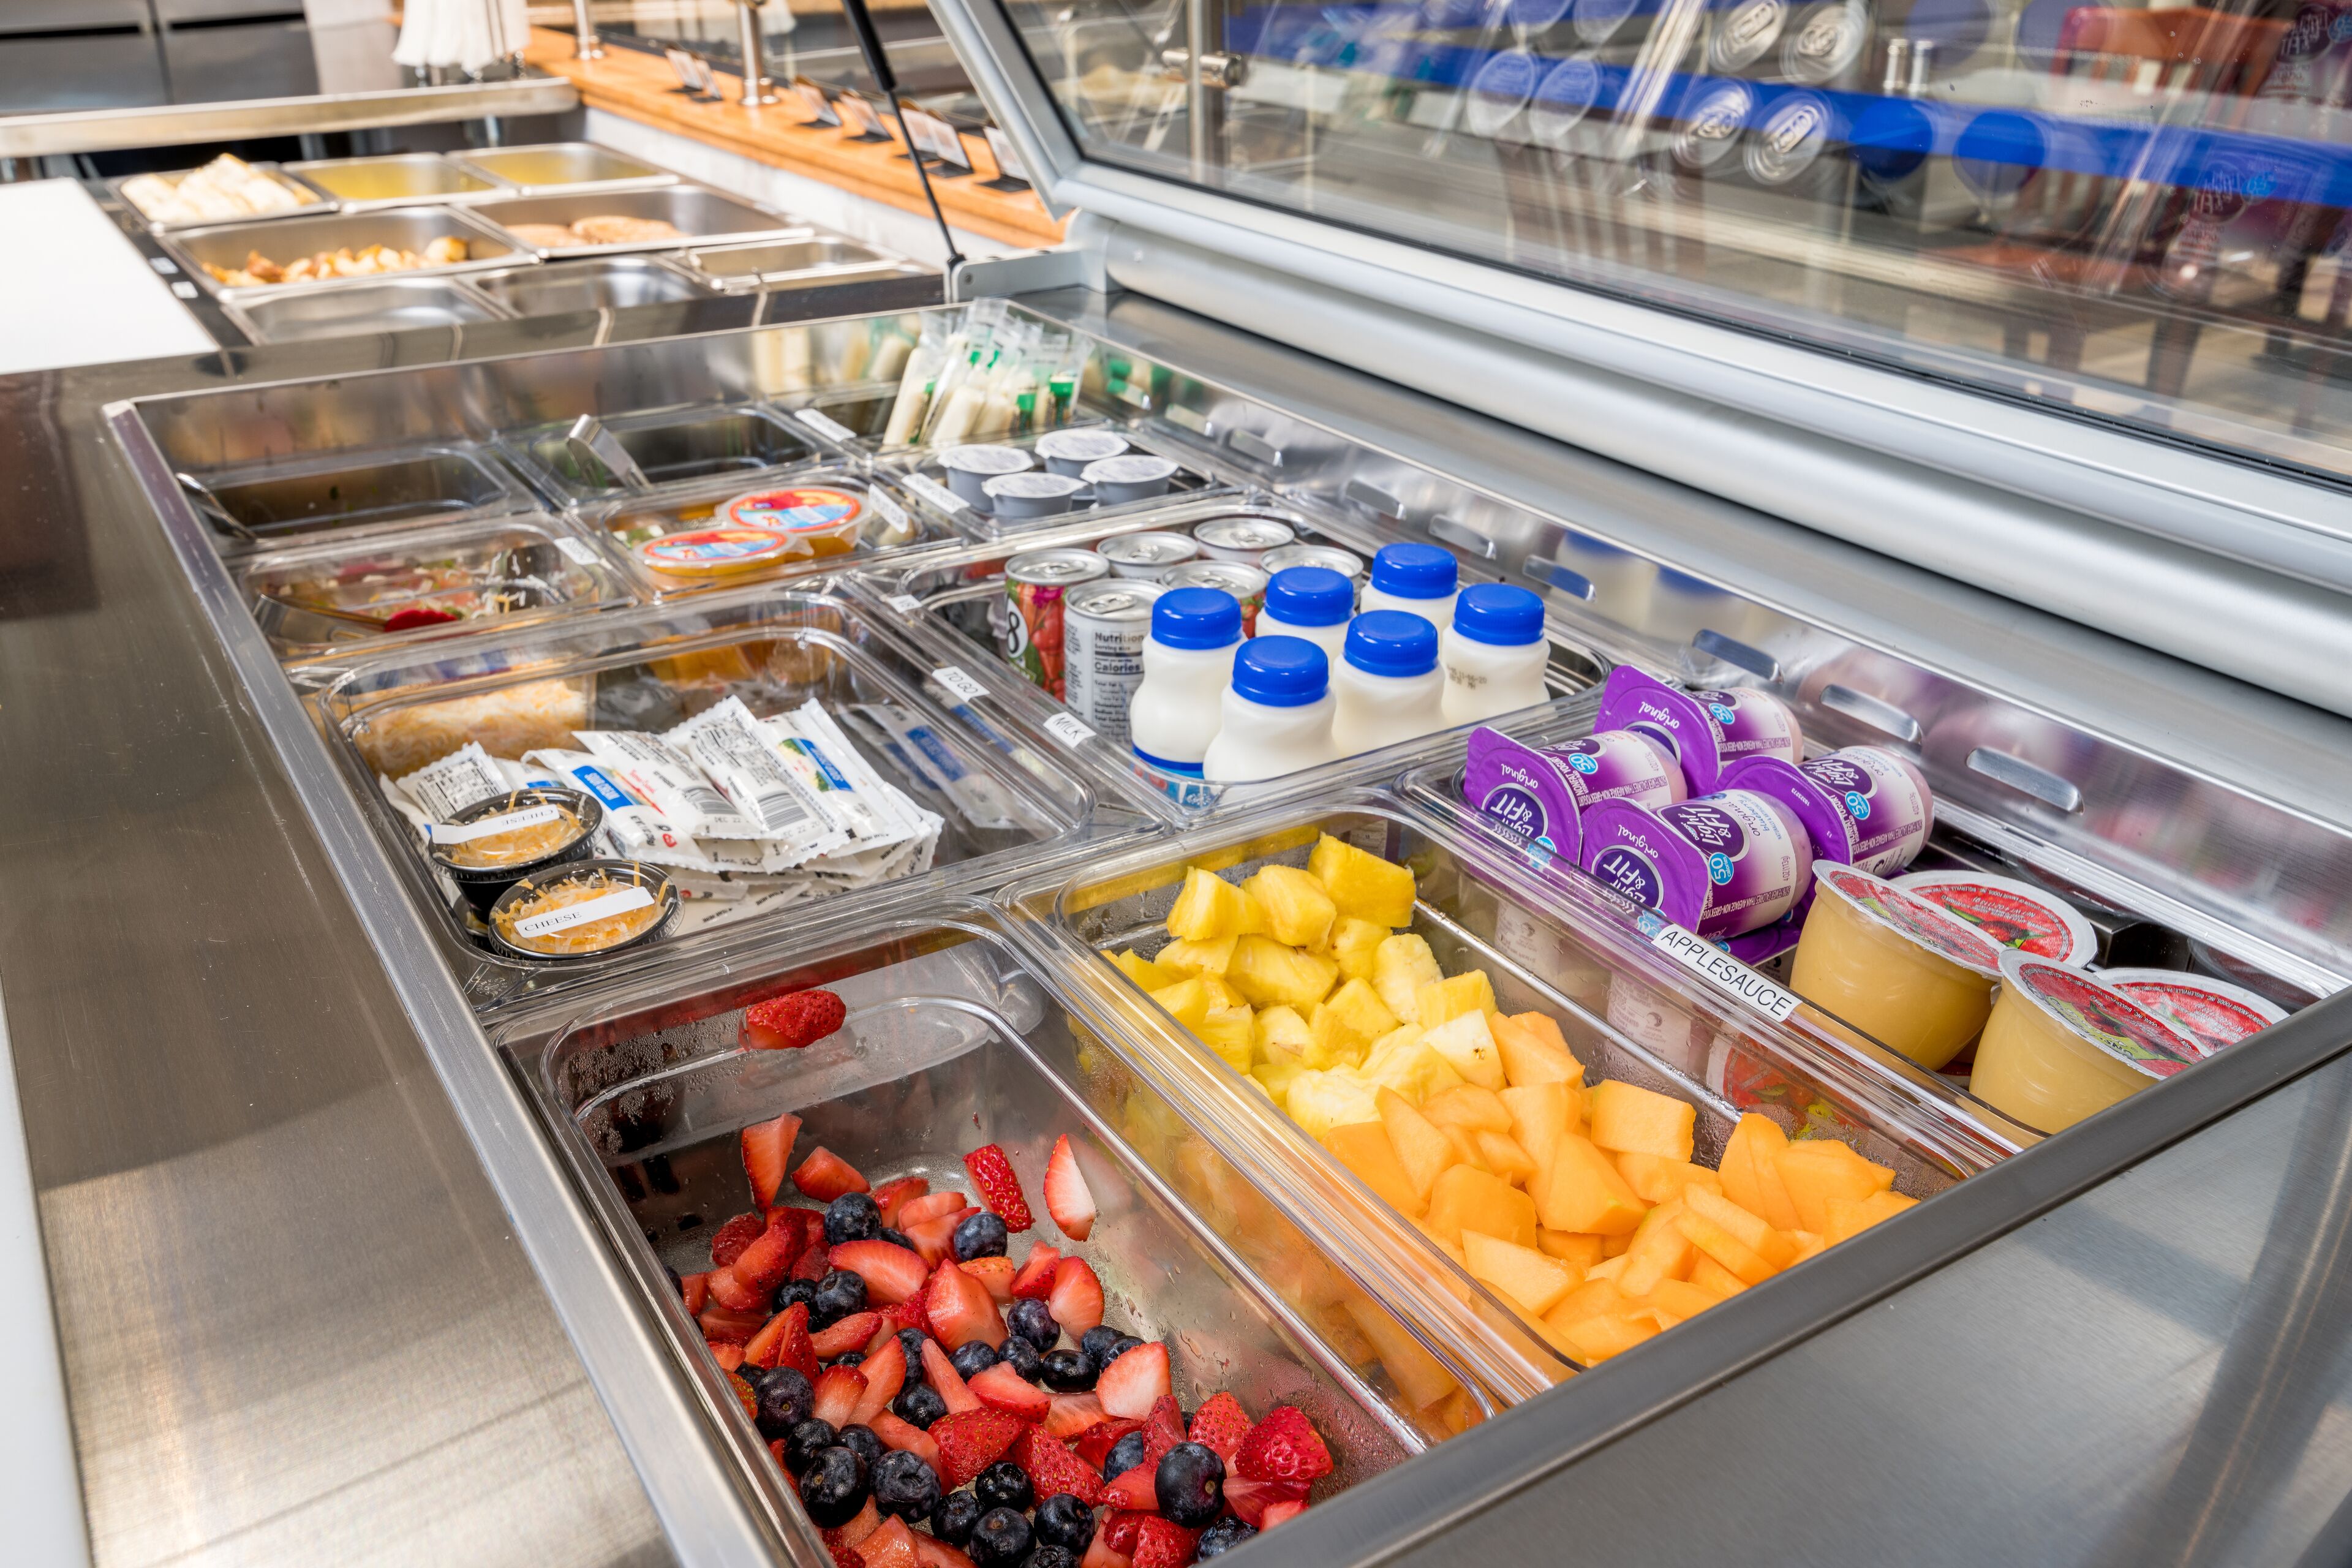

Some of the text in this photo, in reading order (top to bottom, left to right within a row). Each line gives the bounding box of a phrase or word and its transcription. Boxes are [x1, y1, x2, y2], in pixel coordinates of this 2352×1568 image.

[1007, 611, 1020, 655] 8
[1095, 631, 1144, 643] Nutrition
[1095, 662, 1140, 672] Calories
[944, 671, 979, 695] TO GO
[1638, 701, 1680, 729] original
[1053, 717, 1086, 740] MILK
[1548, 756, 1570, 774] YOGURT
[1570, 755, 1591, 771] 50
[1501, 764, 1539, 790] original
[1565, 772, 1585, 795] NONFAT
[1609, 786, 1624, 798] AVERAGE
[1624, 783, 1633, 795] THAN
[1632, 780, 1648, 793] CALORIES
[1590, 789, 1610, 803] NON-GREEK
[1791, 788, 1810, 807] 10323273
[1845, 795, 1862, 815] 50
[501, 809, 554, 827] CHEESE
[1721, 801, 1760, 836] original
[1738, 800, 1770, 831] blueberry
[1678, 813, 1724, 845] Light
[1618, 824, 1659, 859] original
[1812, 843, 1823, 856] OCT
[1714, 858, 1728, 880] 50
[1724, 856, 1733, 877] calories
[1730, 899, 1746, 911] AVERAGE
[1746, 895, 1755, 907] THAN
[1755, 891, 1771, 904] CALORIES
[702, 914, 715, 923] HERE
[1710, 903, 1729, 918] NON-GREEK
[524, 911, 582, 932] CHEESE
[1660, 931, 1792, 1016] APPLESAUCE
[2174, 988, 2204, 998] BIGLERVILLE,
[2204, 993, 2216, 1002] INC.,
[2215, 997, 2233, 1009] FOODS,
[2231, 1004, 2249, 1016] KNOUSE
[2132, 1009, 2144, 1019] INC.,
